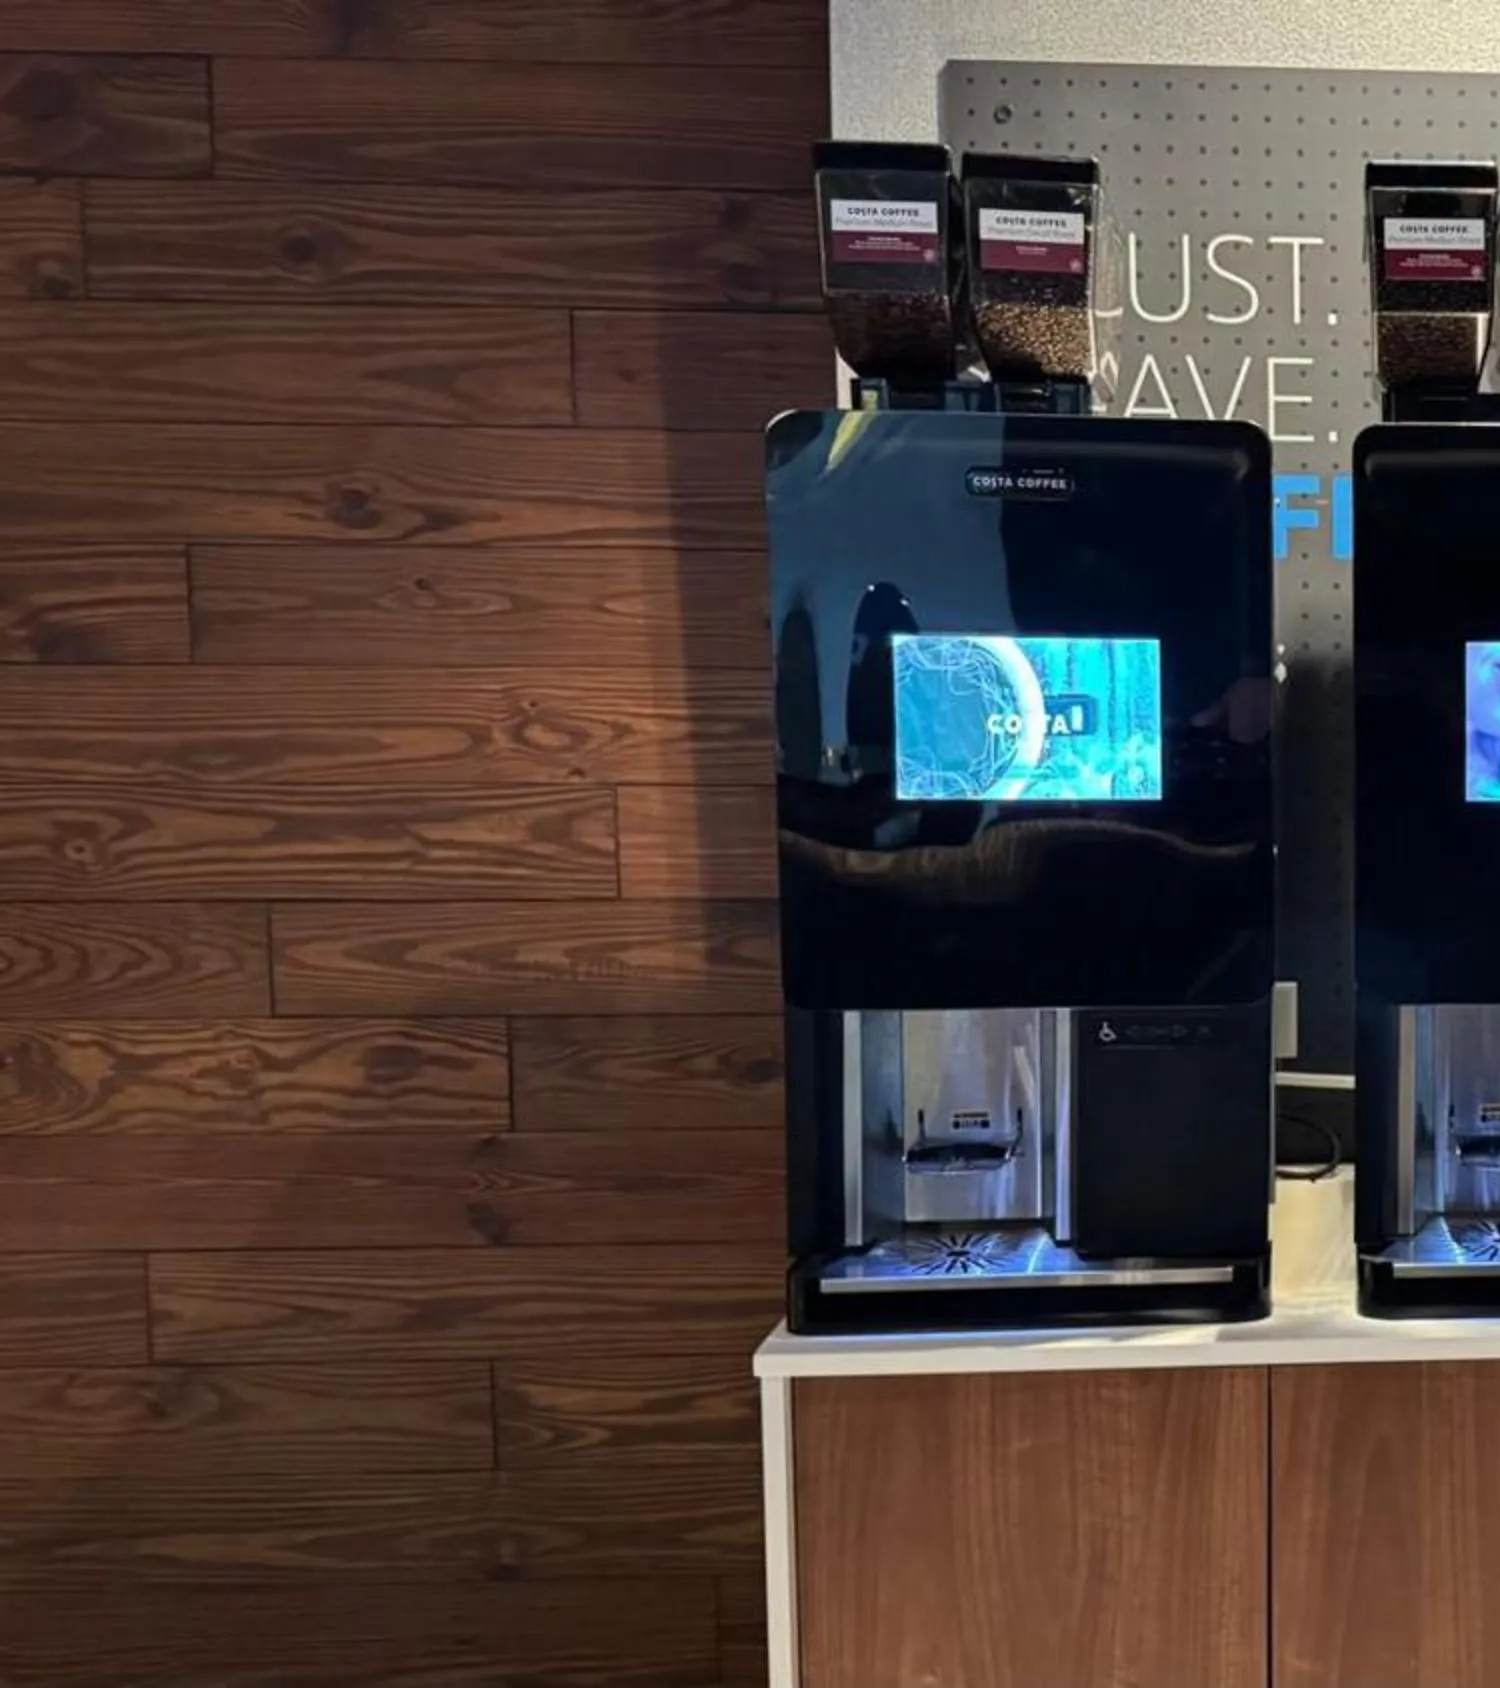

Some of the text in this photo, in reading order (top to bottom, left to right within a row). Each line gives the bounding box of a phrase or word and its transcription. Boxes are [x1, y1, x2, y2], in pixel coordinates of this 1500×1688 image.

[881, 207, 920, 217] COFFEE
[1431, 225, 1468, 234] COFFEE
[972, 476, 1067, 489] COSTA COFFEE
